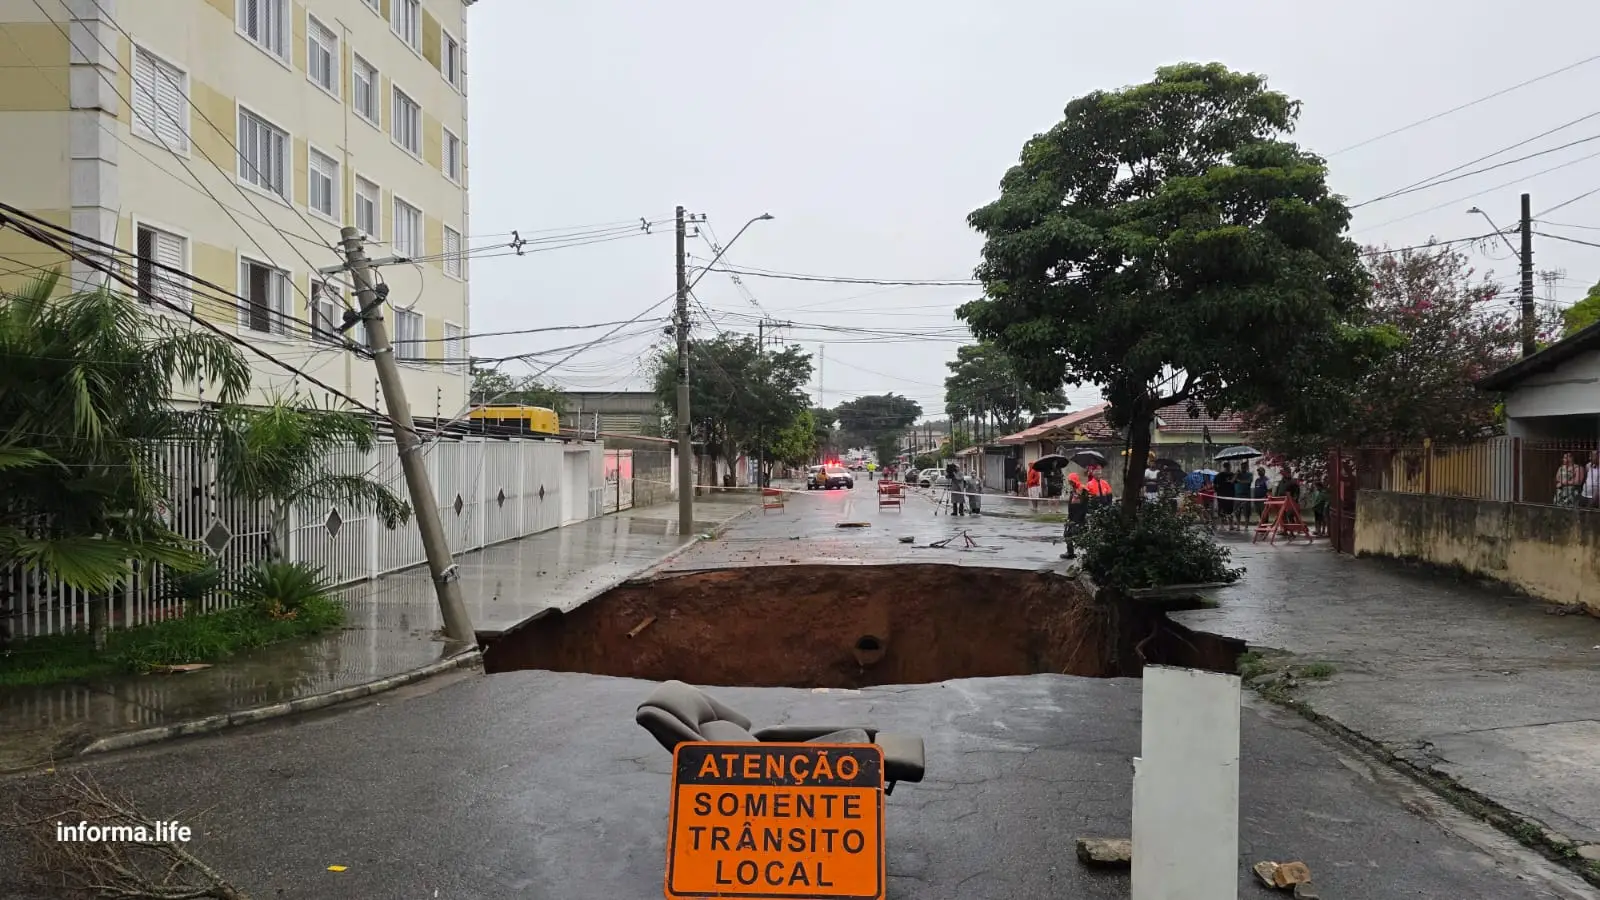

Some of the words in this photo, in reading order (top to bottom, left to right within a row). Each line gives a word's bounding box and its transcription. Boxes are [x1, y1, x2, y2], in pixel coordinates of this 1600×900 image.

[698, 750, 859, 785] ATENÇÃO
[694, 792, 861, 819] SOMENTE
[689, 821, 865, 854] TRÂNSITO
[716, 860, 833, 887] LOCAL
